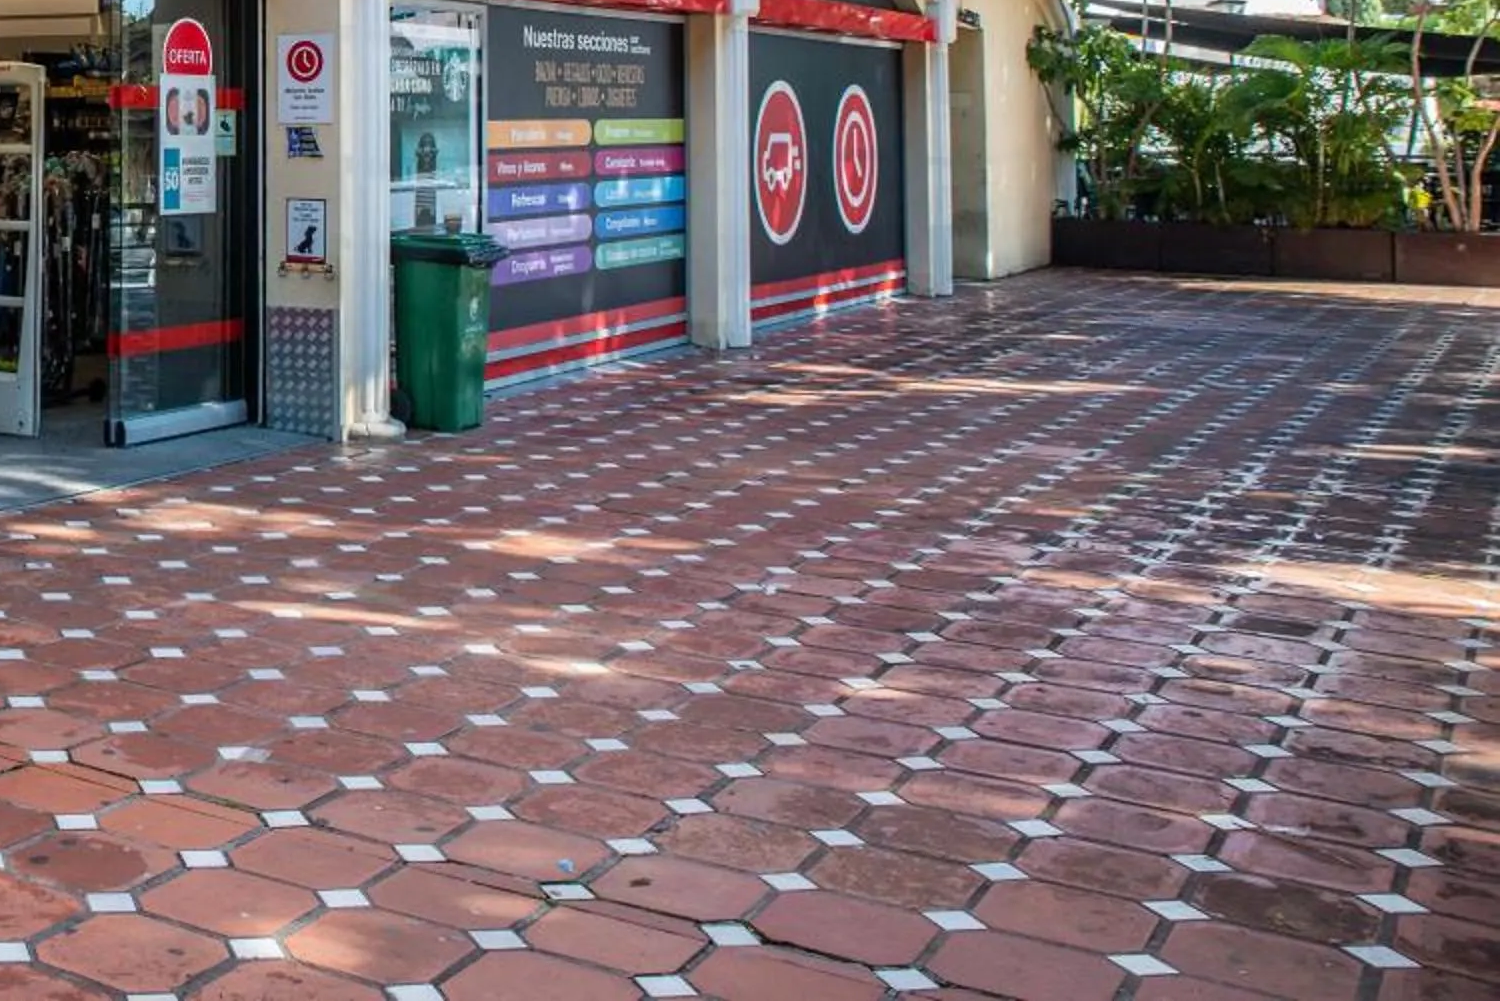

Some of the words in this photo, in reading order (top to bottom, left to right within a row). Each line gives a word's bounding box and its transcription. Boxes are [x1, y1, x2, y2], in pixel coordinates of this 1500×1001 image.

[523, 25, 575, 50] Nuestras
[577, 29, 629, 53] secciones
[168, 49, 207, 66] OFERTA
